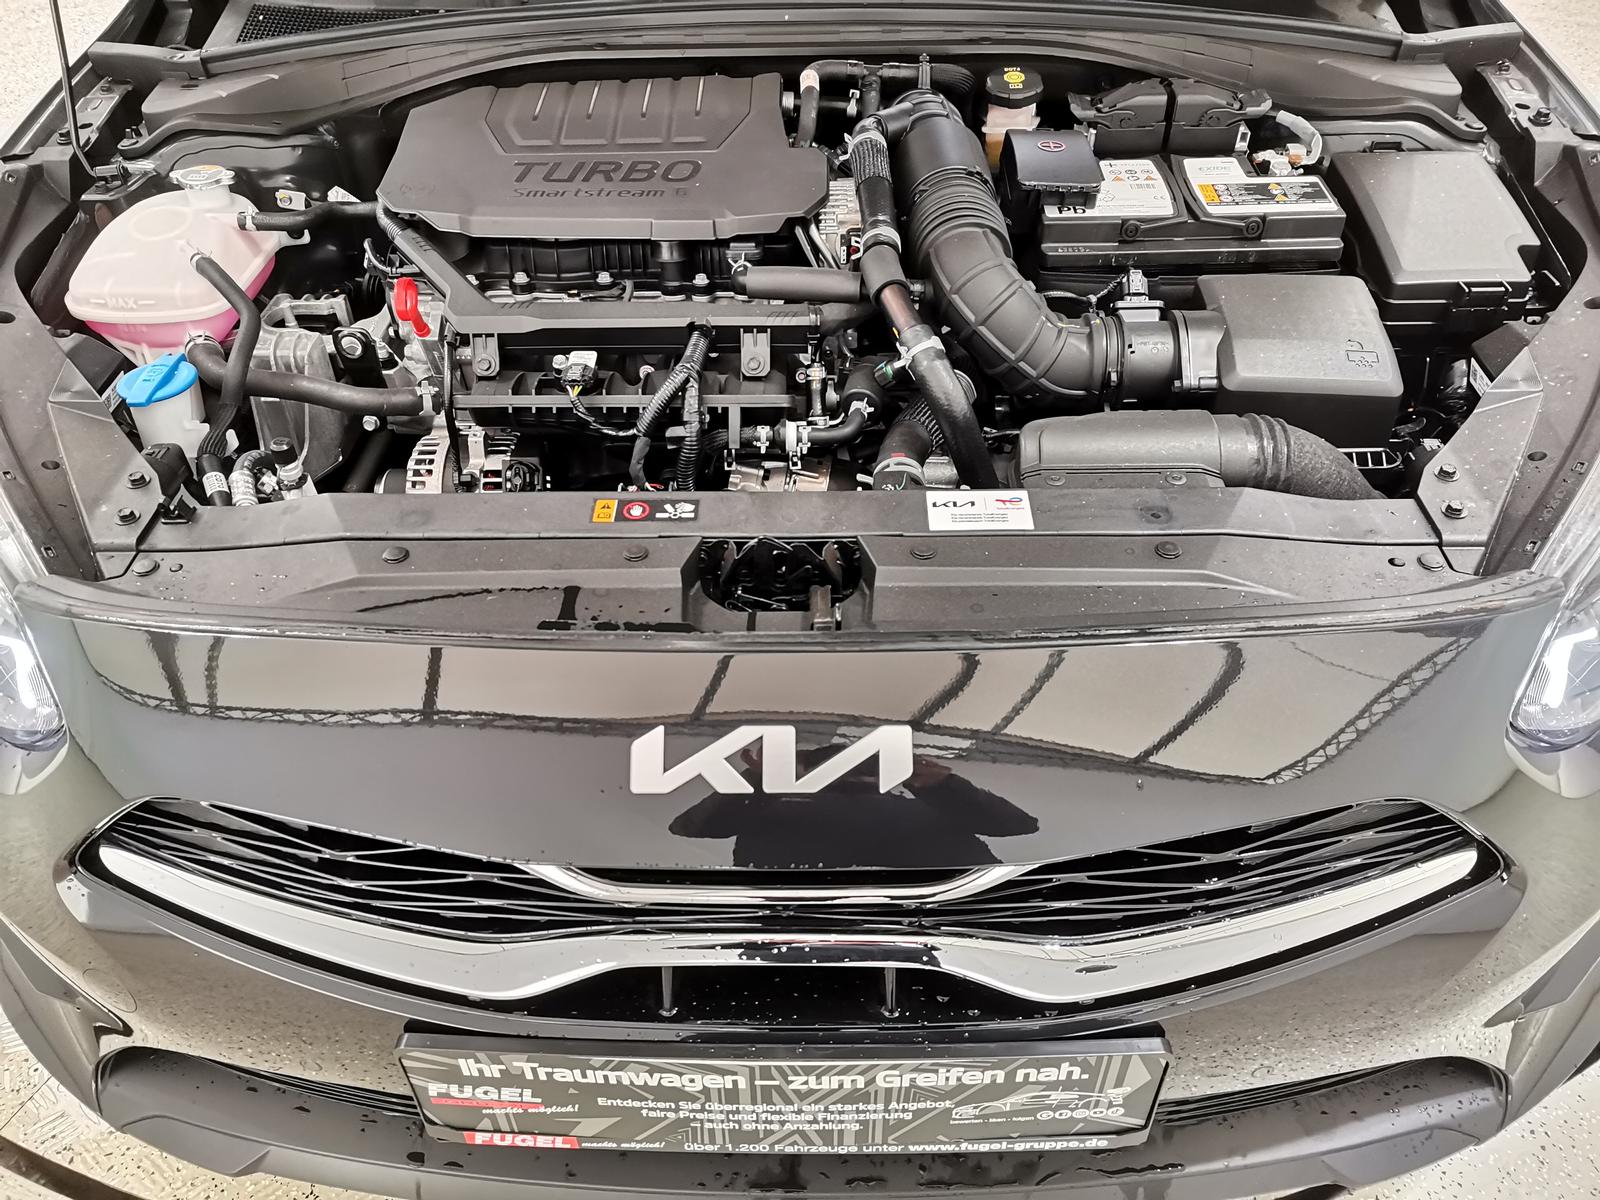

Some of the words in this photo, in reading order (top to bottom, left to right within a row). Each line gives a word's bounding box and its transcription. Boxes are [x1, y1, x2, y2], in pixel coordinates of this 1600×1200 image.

[513, 159, 703, 183] TURBO
[512, 187, 666, 198] Smartstream
[1057, 206, 1086, 214] Pb
[105, 297, 137, 309] MAX
[630, 725, 913, 794] KIA
[457, 1058, 507, 1078] Ihr
[511, 1061, 747, 1092] Traumwagen
[787, 1074, 865, 1090] zum
[875, 1067, 1006, 1088] Greifen
[1015, 1061, 1090, 1083] nah.
[427, 1082, 543, 1103] FUGEL
[527, 1104, 580, 1115] möglich!
[597, 1097, 676, 1110] Entdecken
[678, 1101, 702, 1110] Sie
[704, 1102, 799, 1113] überregional
[801, 1102, 825, 1112] ein
[827, 1102, 886, 1112] starkes
[887, 1099, 956, 1111] Angebot,
[640, 1109, 676, 1119] faire
[679, 1111, 726, 1120] Preise
[728, 1111, 757, 1121] und
[760, 1112, 814, 1121] flexible
[817, 1111, 914, 1121] Finanzierung
[703, 1122, 740, 1130] auch
[742, 1122, 780, 1131] ohne
[782, 1121, 864, 1132] Anzahlung.
[473, 1133, 572, 1149] FUGEL
[684, 1142, 721, 1152] über
[725, 1143, 770, 1153] 1.200
[774, 1144, 859, 1154] Fahrzeuge
[862, 1144, 905, 1153] unter
[908, 1138, 1109, 1153] www.fugel-gruppe.de
